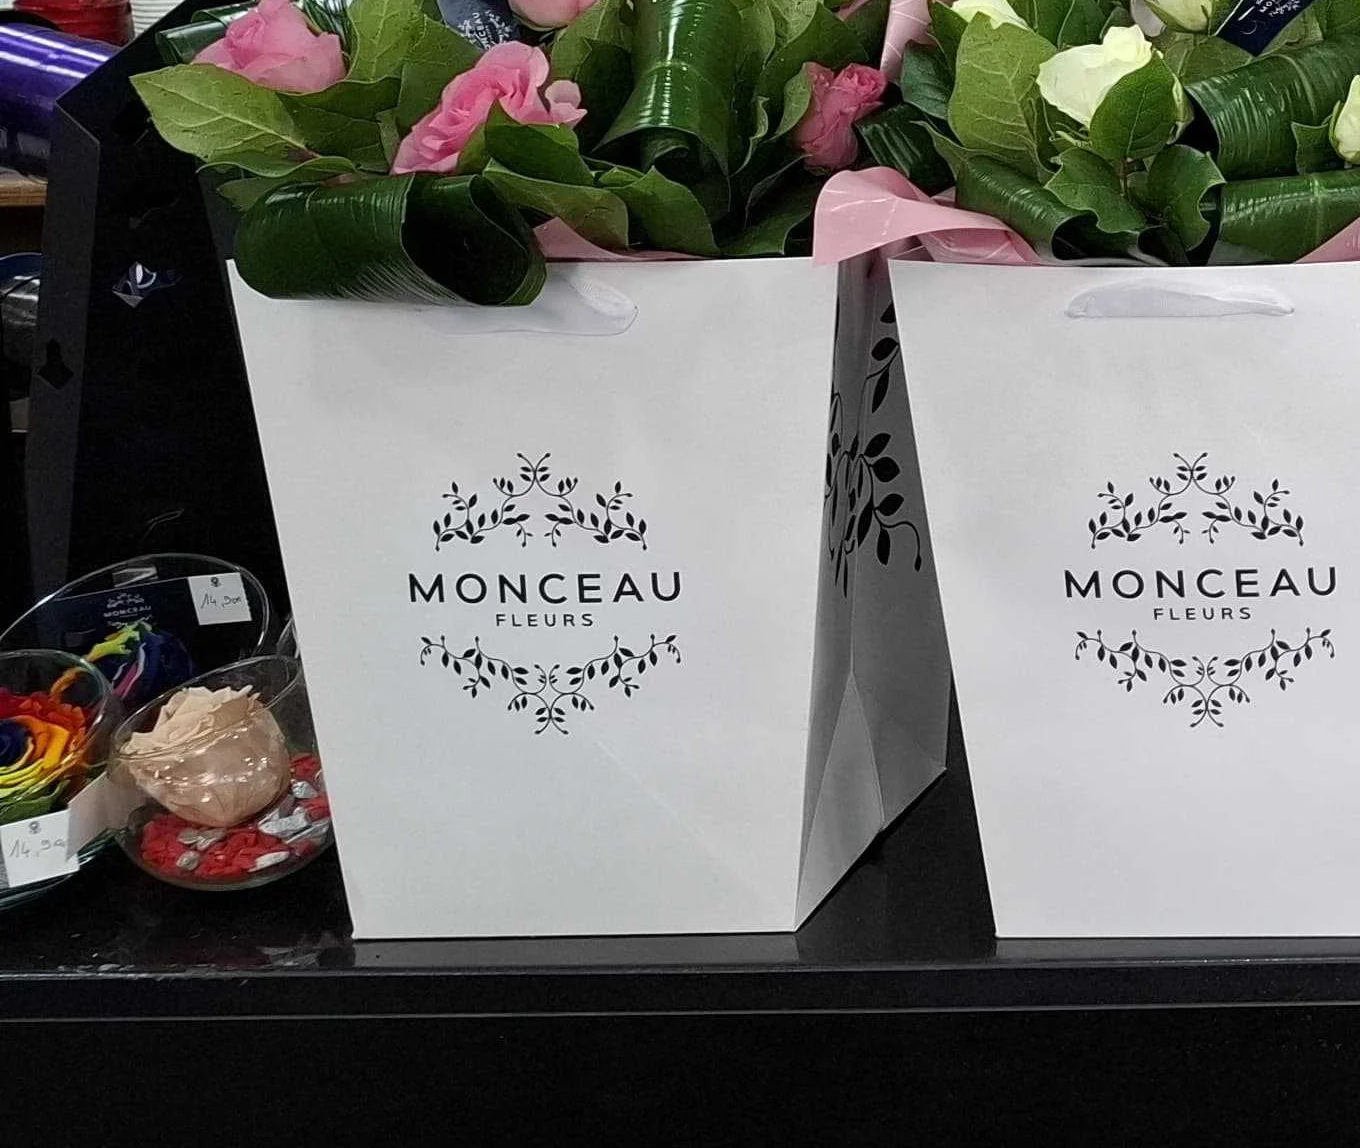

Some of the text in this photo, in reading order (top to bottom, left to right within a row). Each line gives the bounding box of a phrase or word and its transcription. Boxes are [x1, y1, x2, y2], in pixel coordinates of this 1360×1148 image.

[409, 572, 681, 604] MONCEAU
[1065, 567, 1336, 599] MONCEAU
[496, 613, 594, 627] FLEURS
[1153, 608, 1251, 621] FLEURS
